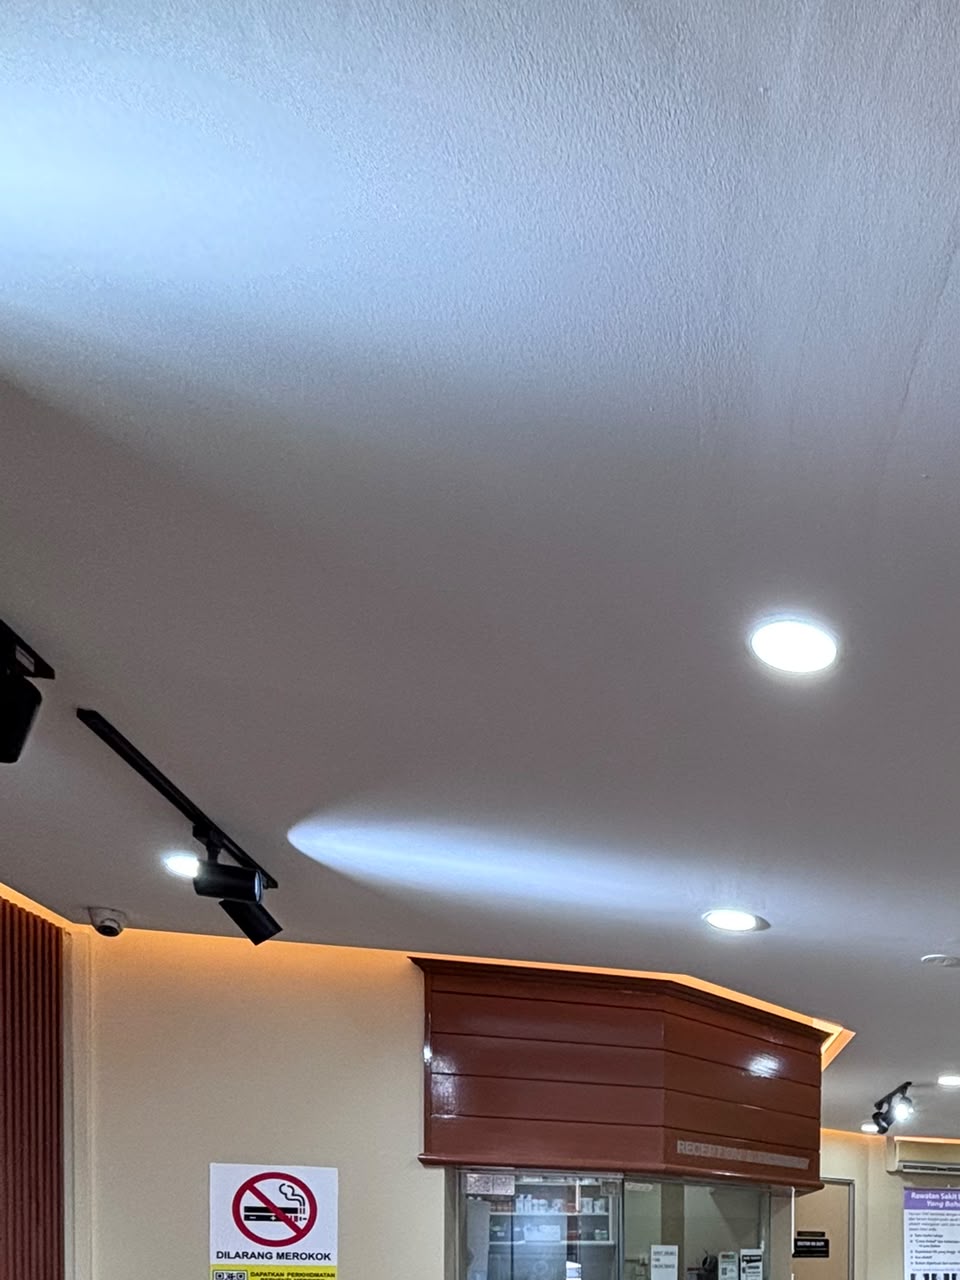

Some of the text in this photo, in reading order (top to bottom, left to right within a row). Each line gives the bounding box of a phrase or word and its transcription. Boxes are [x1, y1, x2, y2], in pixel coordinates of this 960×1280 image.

[911, 1192, 940, 1200] Rawatan
[940, 1192, 957, 1200] Sakit
[926, 1200, 944, 1208] Yang
[216, 1250, 331, 1261] DILARANG MEROKOK
